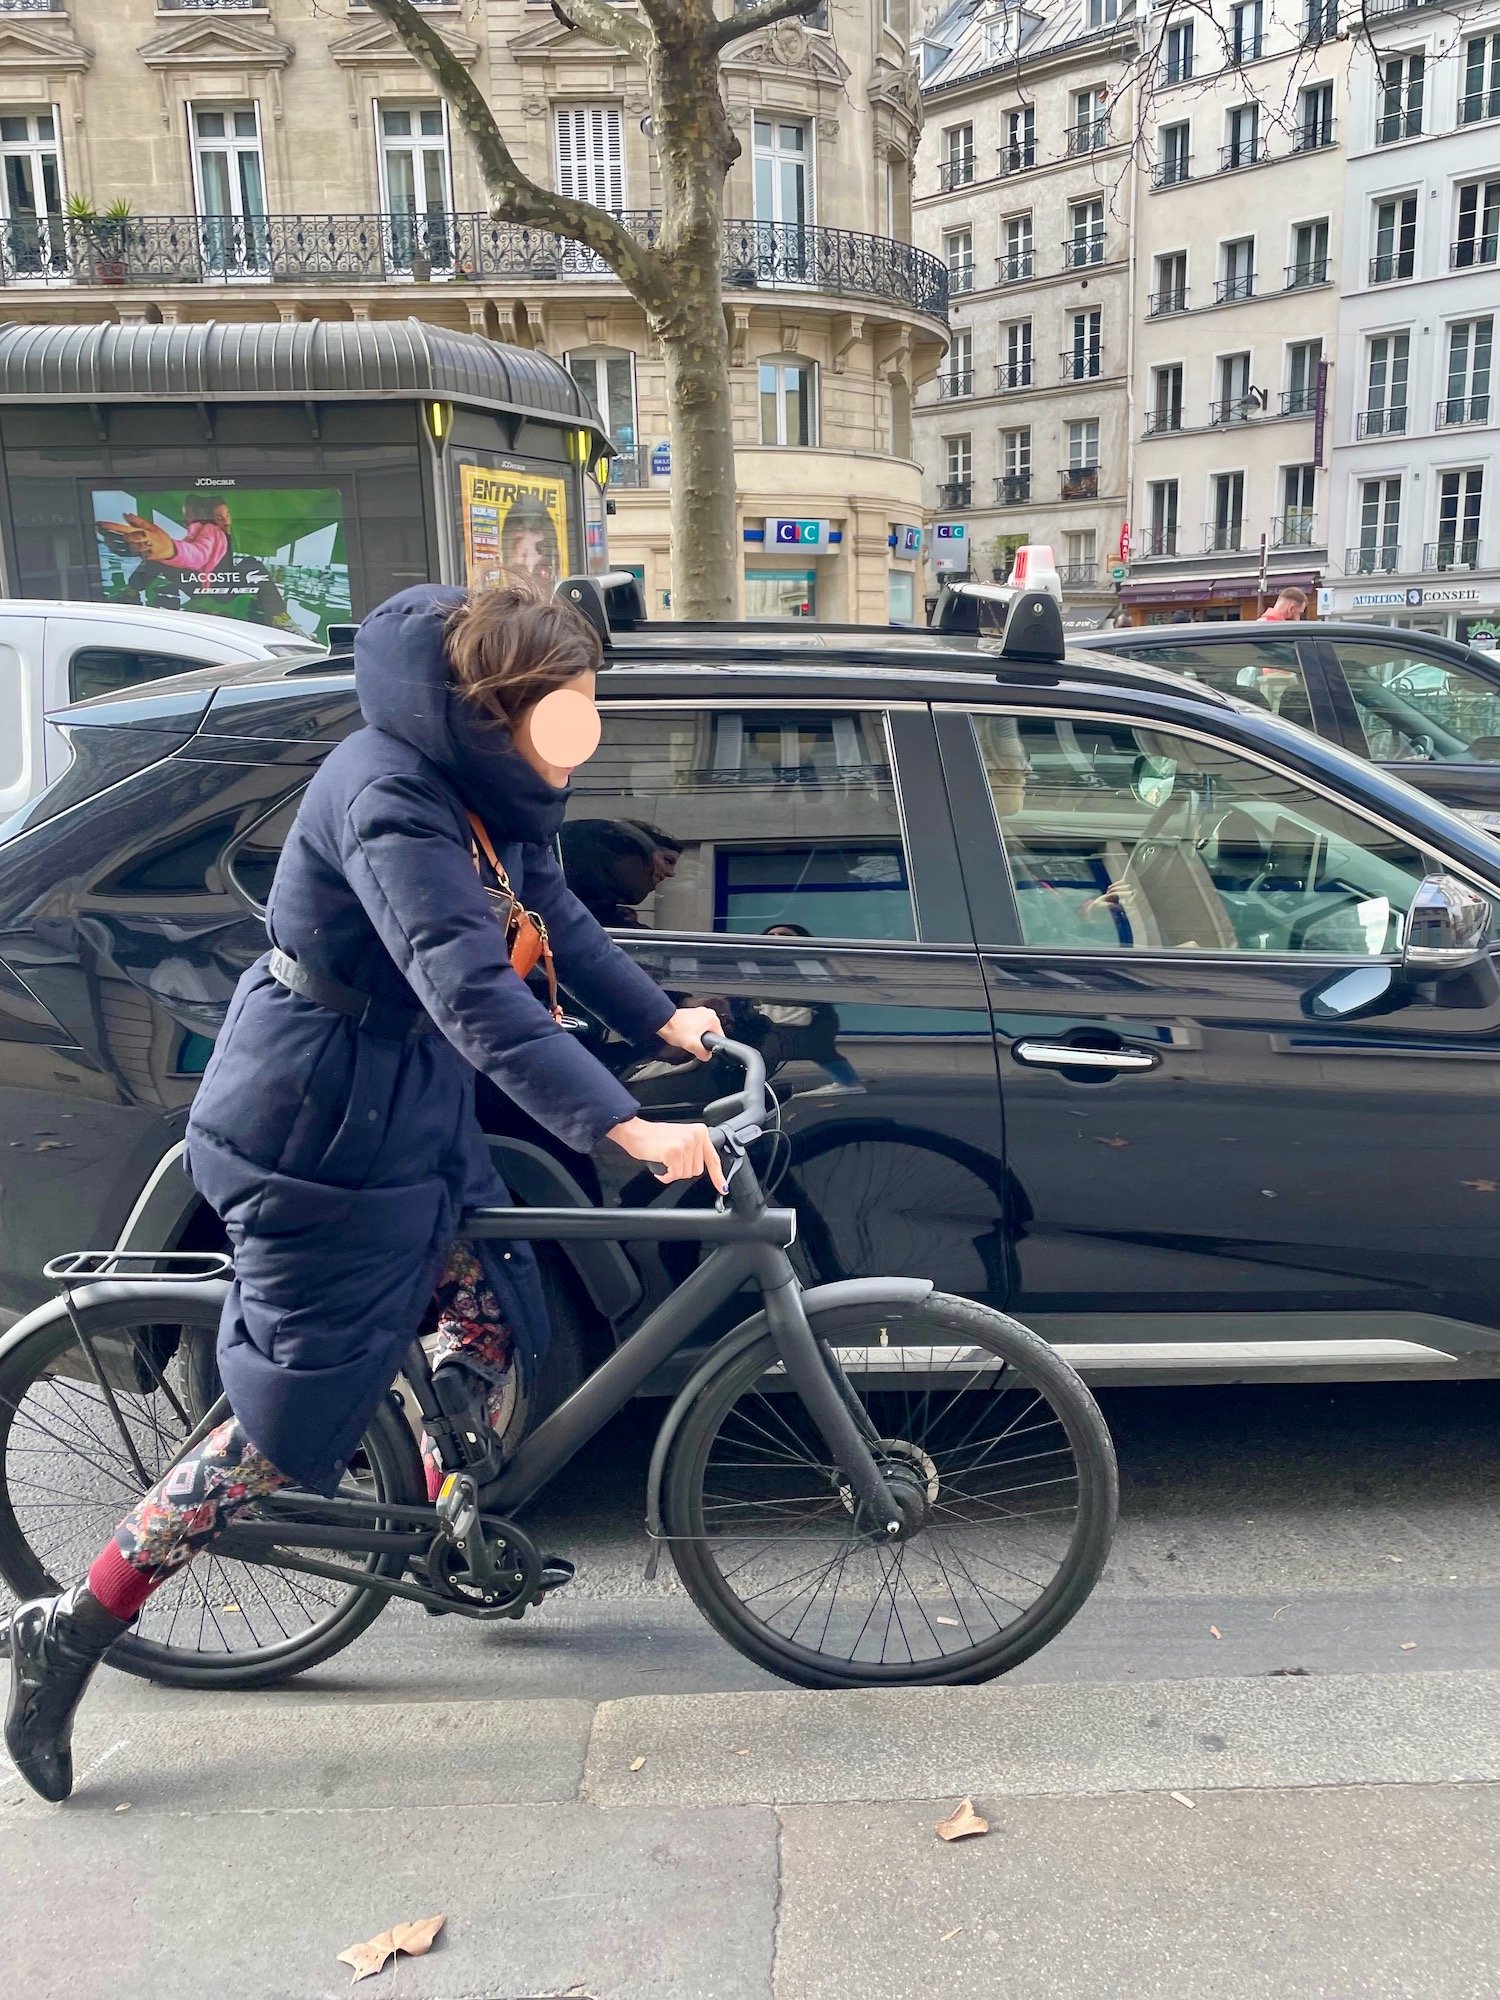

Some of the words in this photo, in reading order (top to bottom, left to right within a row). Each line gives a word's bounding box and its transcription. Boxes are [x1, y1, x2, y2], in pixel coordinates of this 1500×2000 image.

[195, 478, 236, 486] JCDecaux
[780, 525, 816, 541] CIC
[938, 527, 963, 537] CIC
[180, 572, 241, 583] LACOSTE
[1353, 594, 1405, 605] AUDITION
[1423, 589, 1480, 600] CONSEIL
